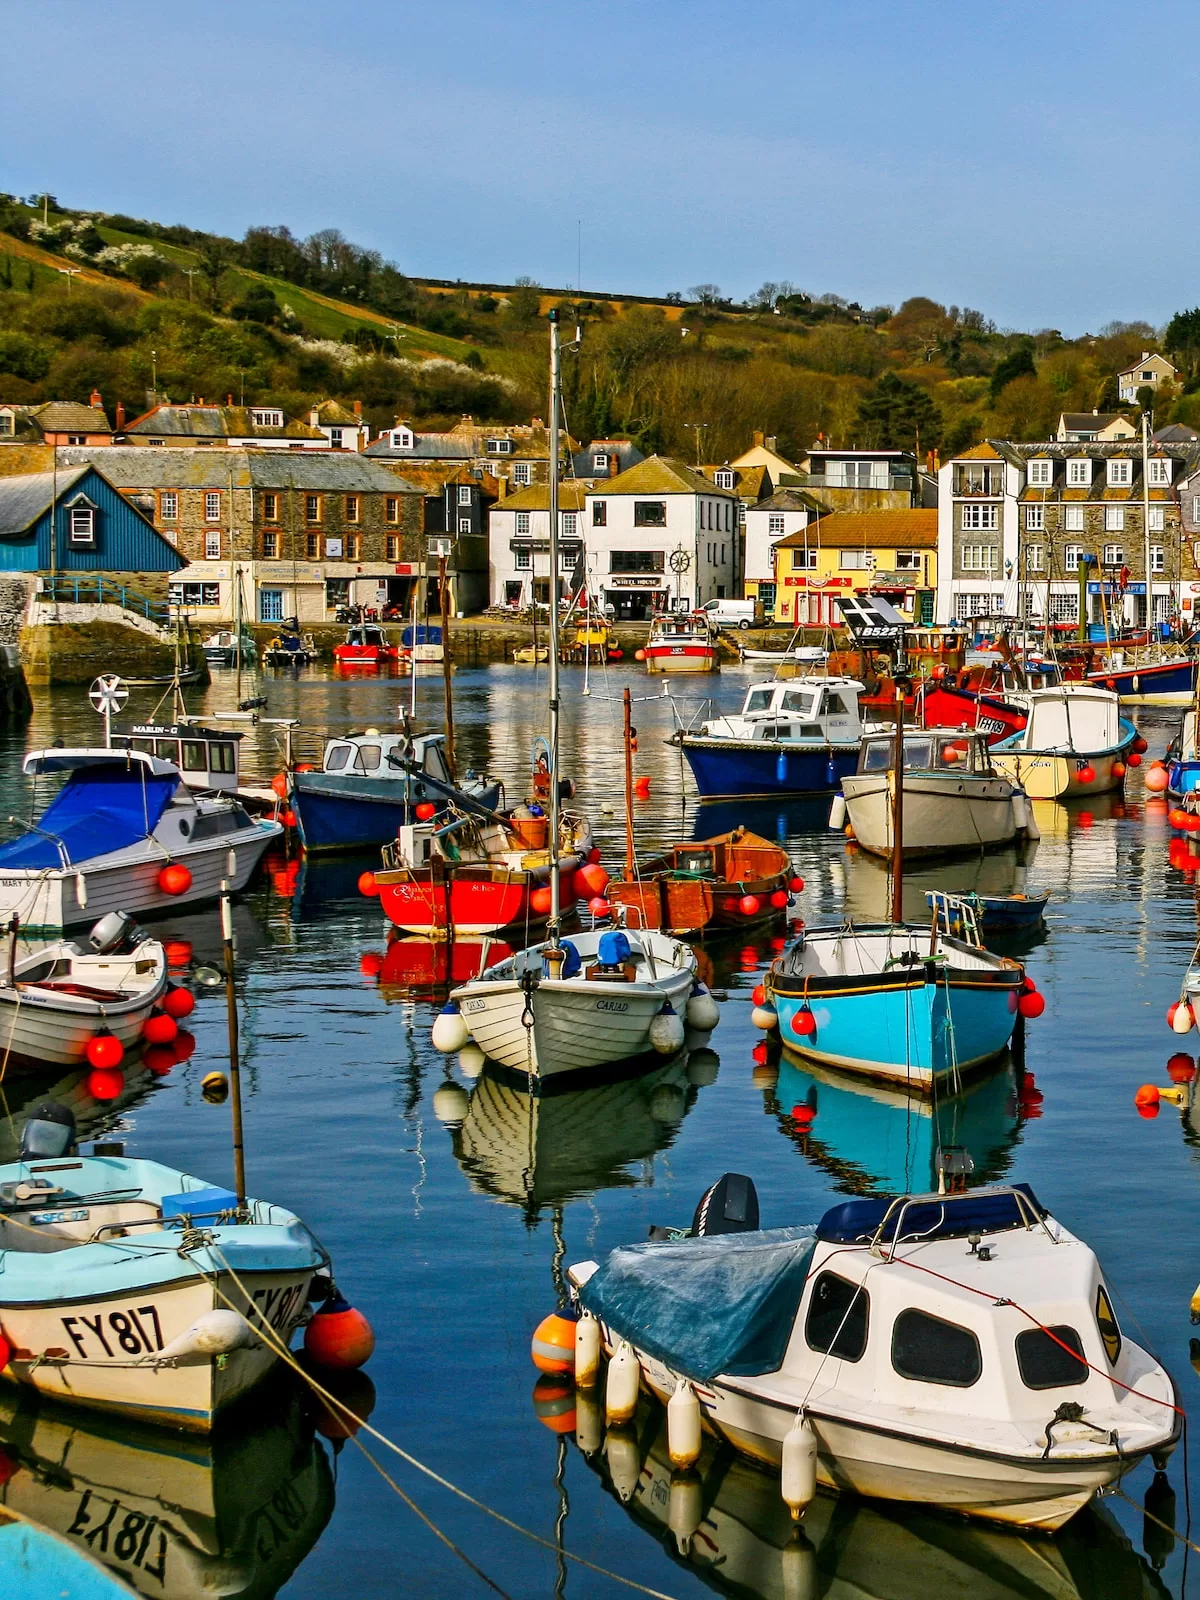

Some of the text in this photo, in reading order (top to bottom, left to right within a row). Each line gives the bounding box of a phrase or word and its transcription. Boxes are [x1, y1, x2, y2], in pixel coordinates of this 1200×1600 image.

[2, 879, 22, 888] MARY
[596, 1000, 629, 1012] CARIAD
[246, 1283, 304, 1332] FY817
[61, 1304, 165, 1359] FY817
